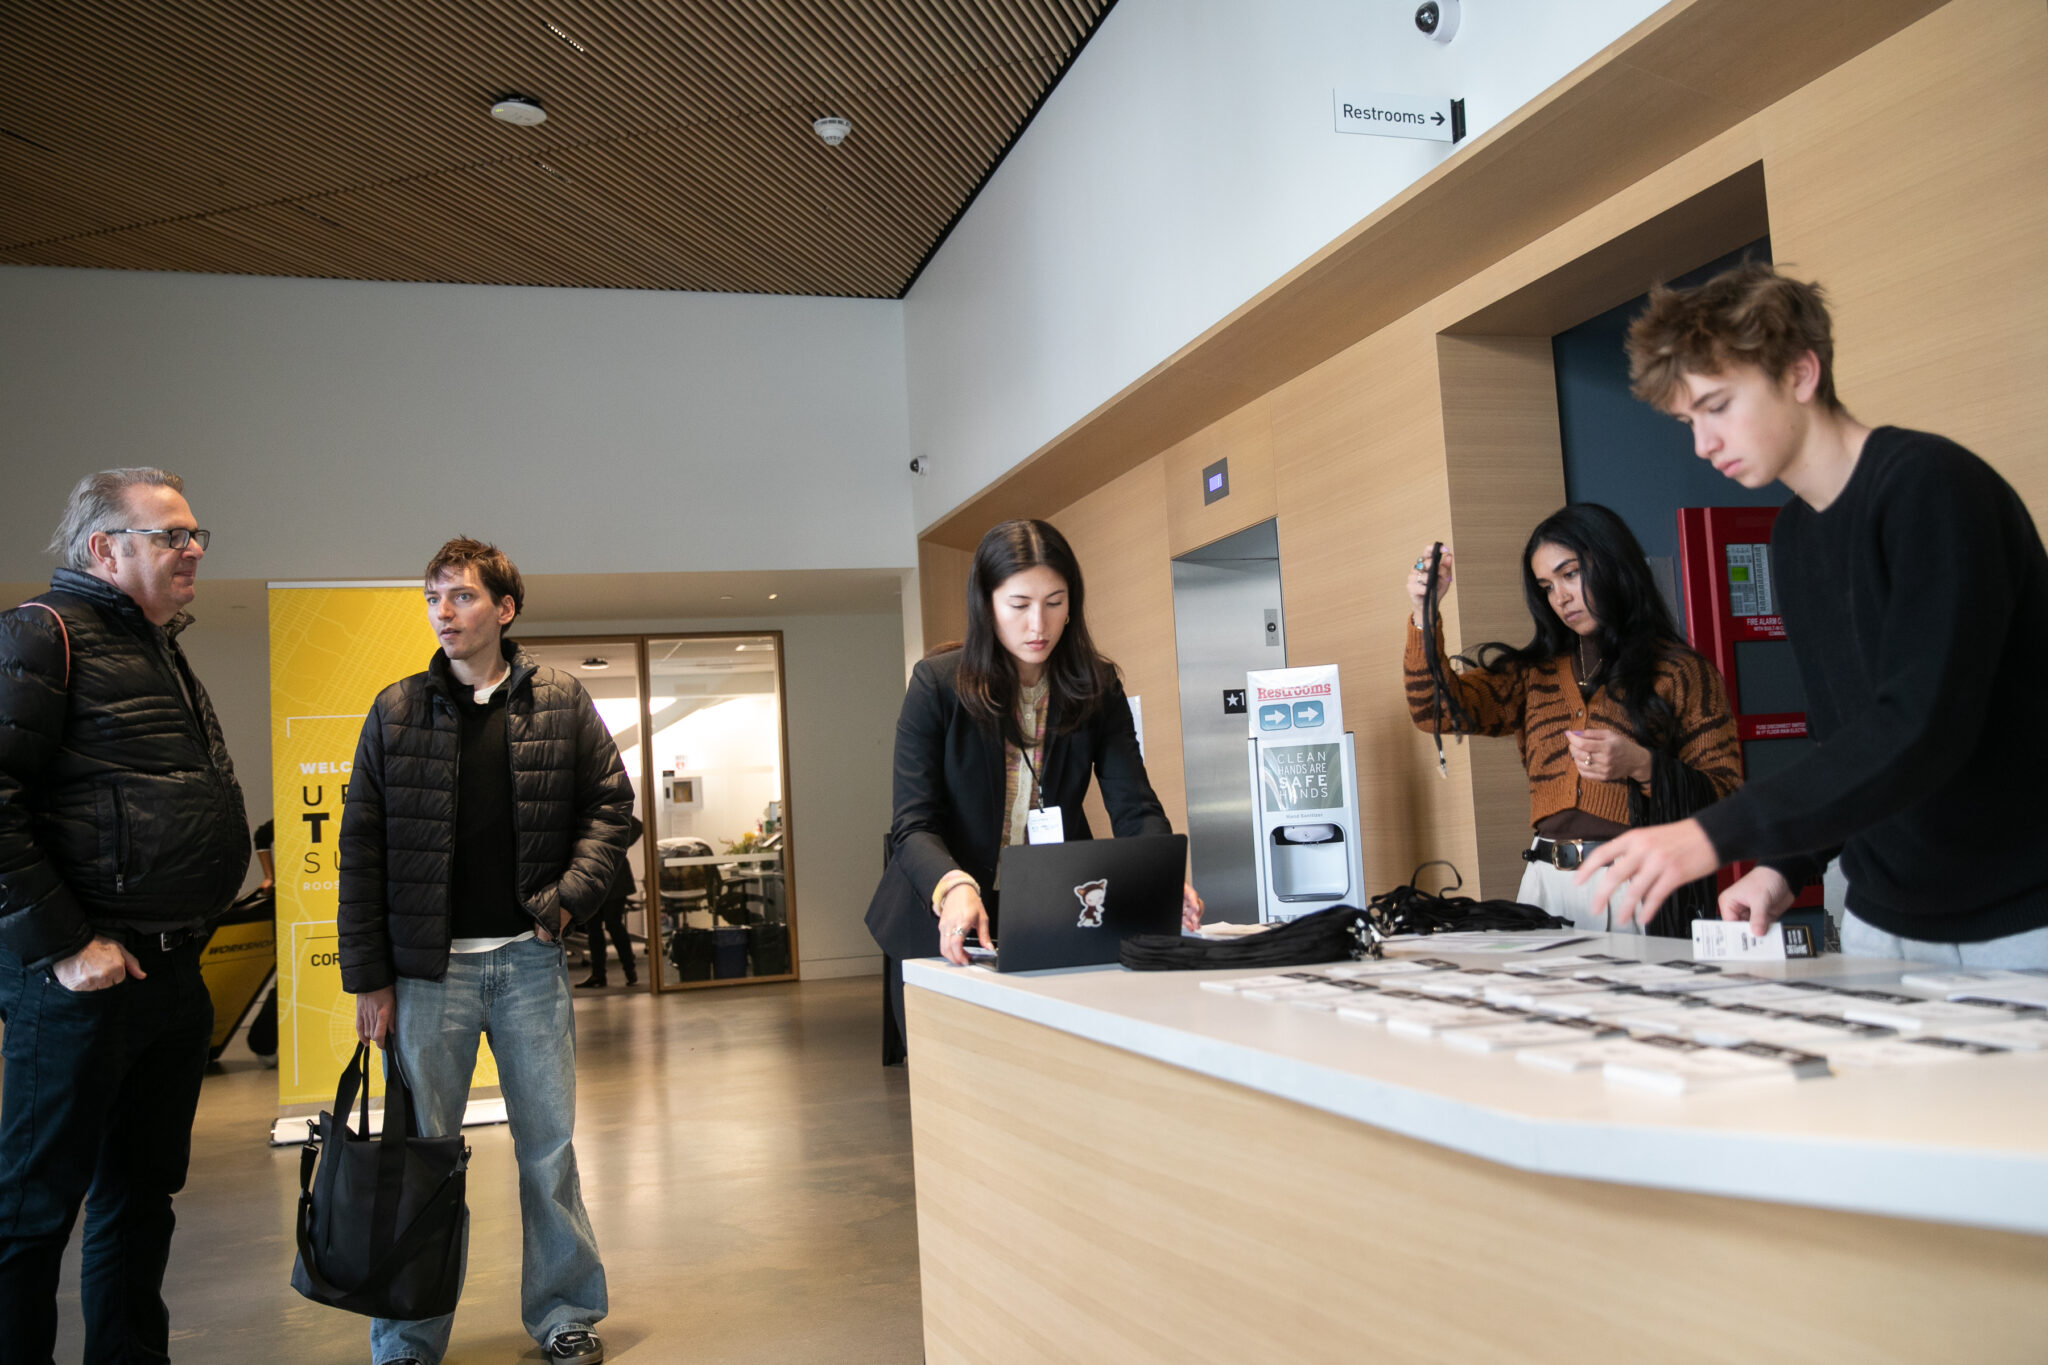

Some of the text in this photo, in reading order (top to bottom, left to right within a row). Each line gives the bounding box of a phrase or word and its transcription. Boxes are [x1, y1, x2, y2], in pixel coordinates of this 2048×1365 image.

[1343, 104, 1425, 125] Restrooms
[1746, 618, 1758, 626] FIRE
[1759, 617, 1777, 625] ALARM
[1257, 683, 1331, 699] Restrooms
[1277, 752, 1326, 764] CLEAN
[1278, 763, 1327, 775] HANDS ARE
[1279, 775, 1327, 789] SAFE
